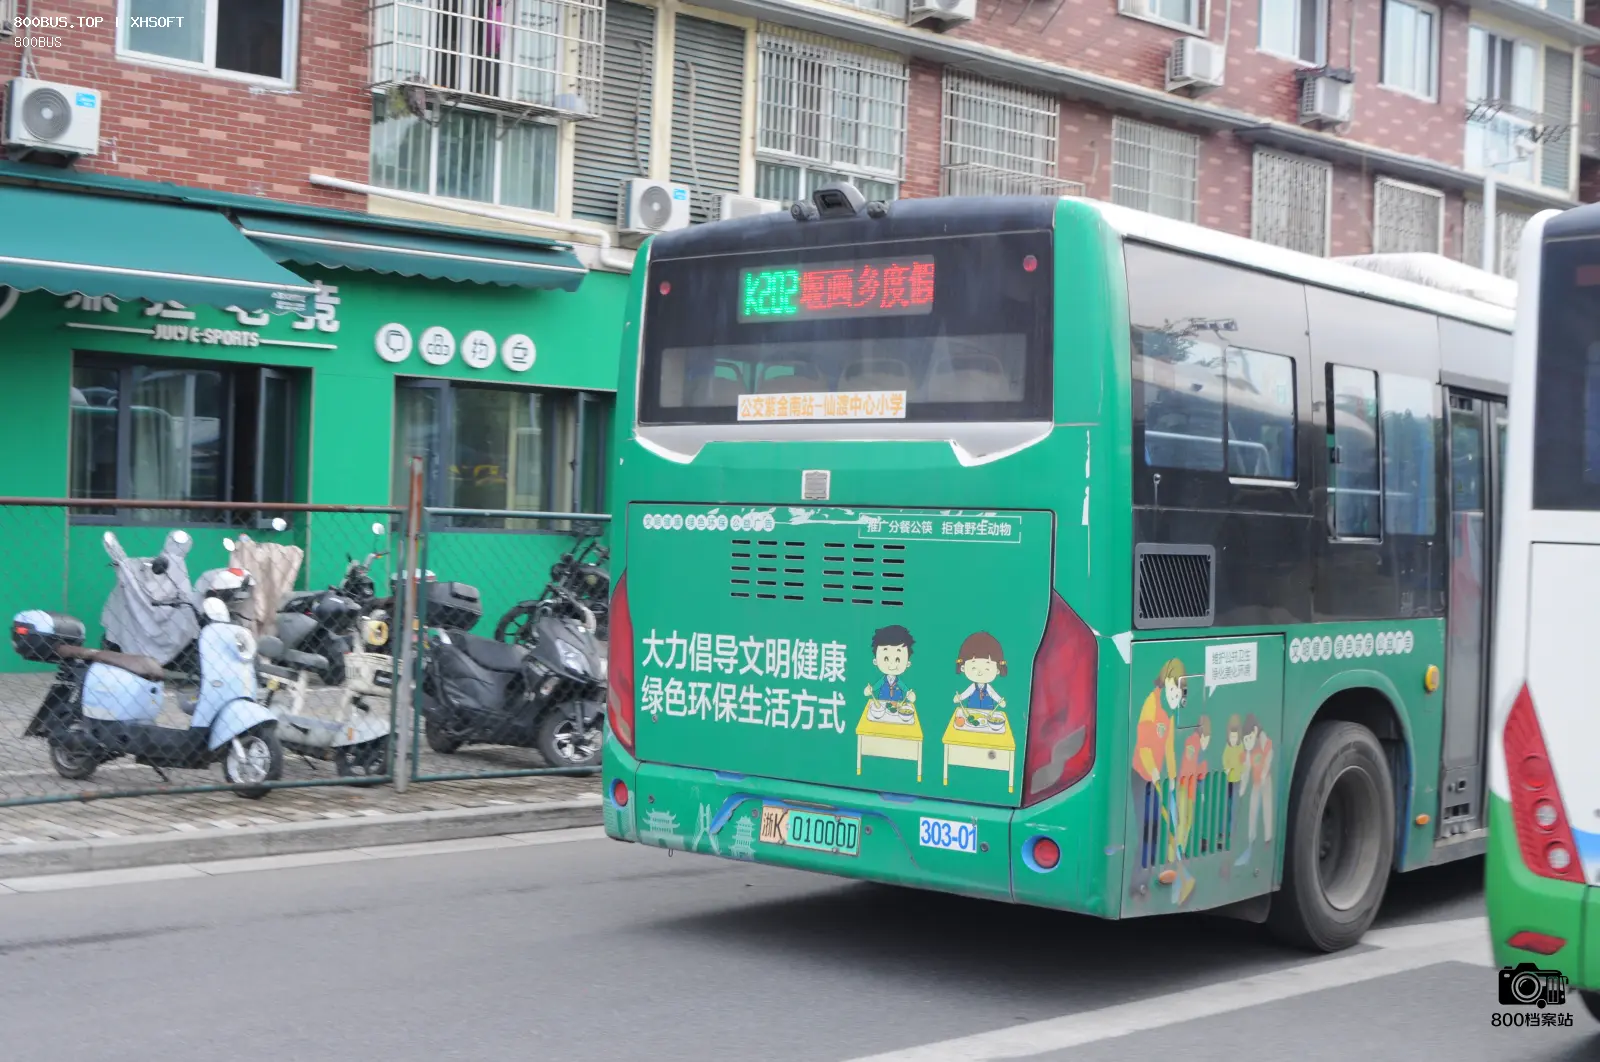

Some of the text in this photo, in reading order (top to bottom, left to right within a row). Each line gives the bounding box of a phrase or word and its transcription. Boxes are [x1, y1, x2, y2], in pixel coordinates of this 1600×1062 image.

[745, 271, 798, 315] K202
[189, 327, 260, 347] E-SPORTS
[866, 519, 1012, 537] 推广分餐公筷 拒食野生动物
[641, 628, 848, 683] 大力倡导文明健康
[641, 675, 847, 734] 绿色环保生活方式
[920, 819, 977, 851] 303-01
